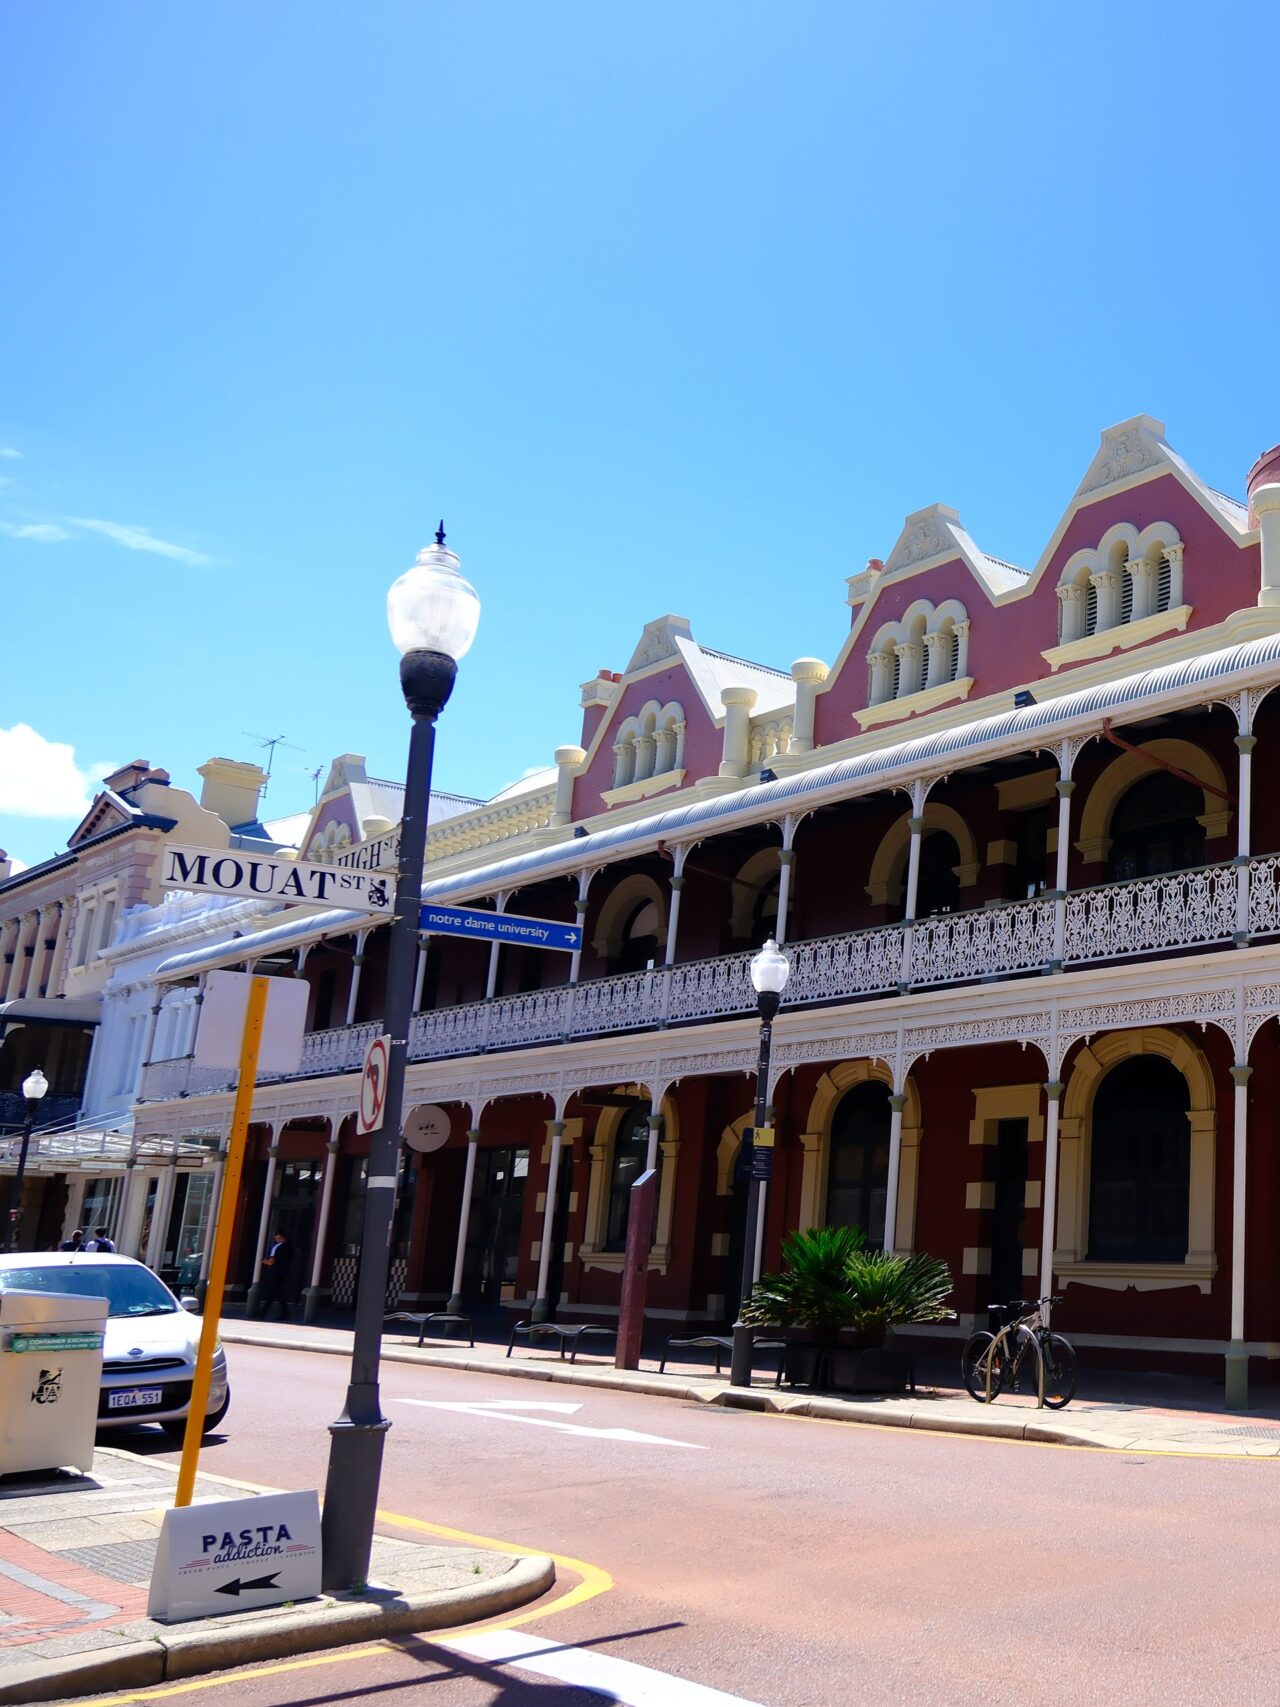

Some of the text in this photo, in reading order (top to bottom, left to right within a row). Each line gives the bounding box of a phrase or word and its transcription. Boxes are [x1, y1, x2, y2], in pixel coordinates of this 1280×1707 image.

[166, 851, 366, 901] MOUAT ST
[428, 913, 550, 941] notre dame university
[202, 1524, 292, 1553] PASTA
[213, 1541, 284, 1564] addiction
